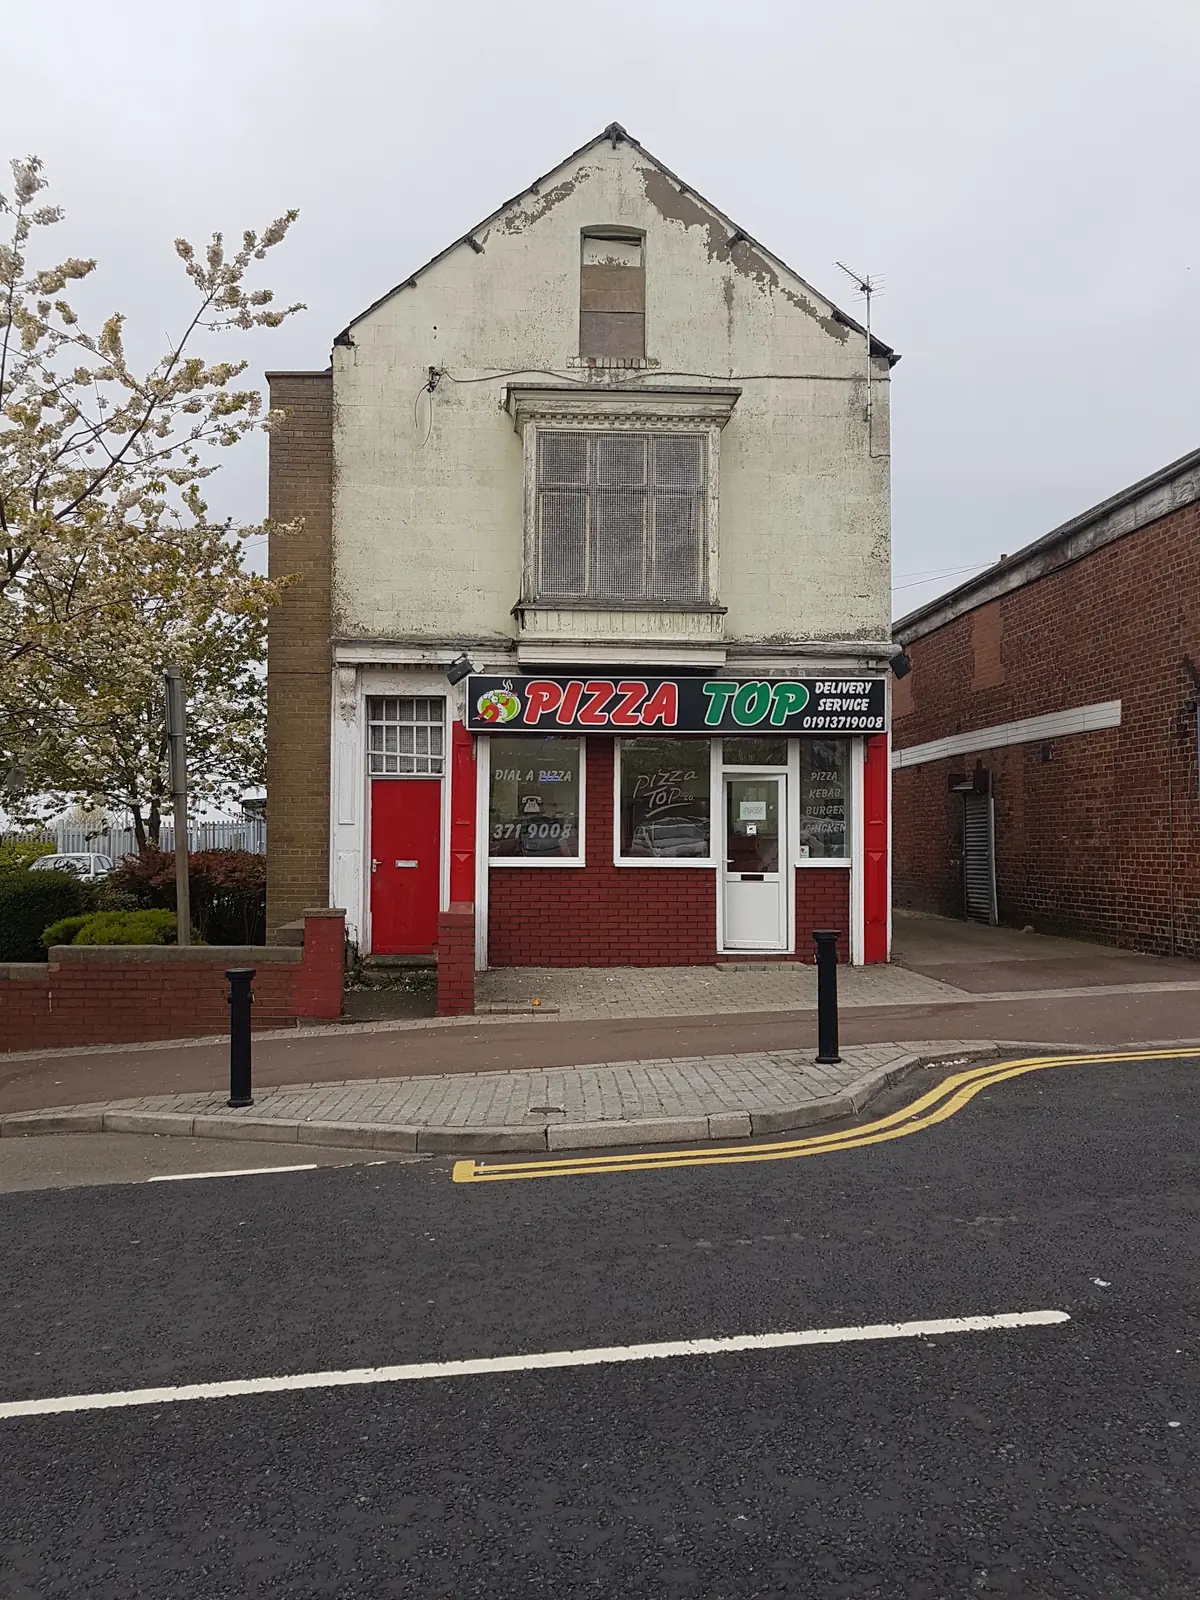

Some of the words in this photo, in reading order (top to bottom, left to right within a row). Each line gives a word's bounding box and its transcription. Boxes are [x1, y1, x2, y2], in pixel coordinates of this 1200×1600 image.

[815, 682, 872, 694] DELIVERY
[523, 680, 678, 726] PIZZA
[703, 681, 809, 726] TOP
[818, 698, 869, 711] SERVICE
[803, 716, 883, 728] 01913719008
[495, 769, 521, 780] DIAL
[526, 770, 533, 781] A
[539, 771, 572, 781] PIZZA
[811, 772, 838, 780] PIZZA
[809, 788, 840, 798] KEBAB
[806, 805, 844, 815] BURGER
[493, 824, 522, 838] 371
[528, 824, 572, 838] 9008
[805, 823, 846, 833] CHICKEN
